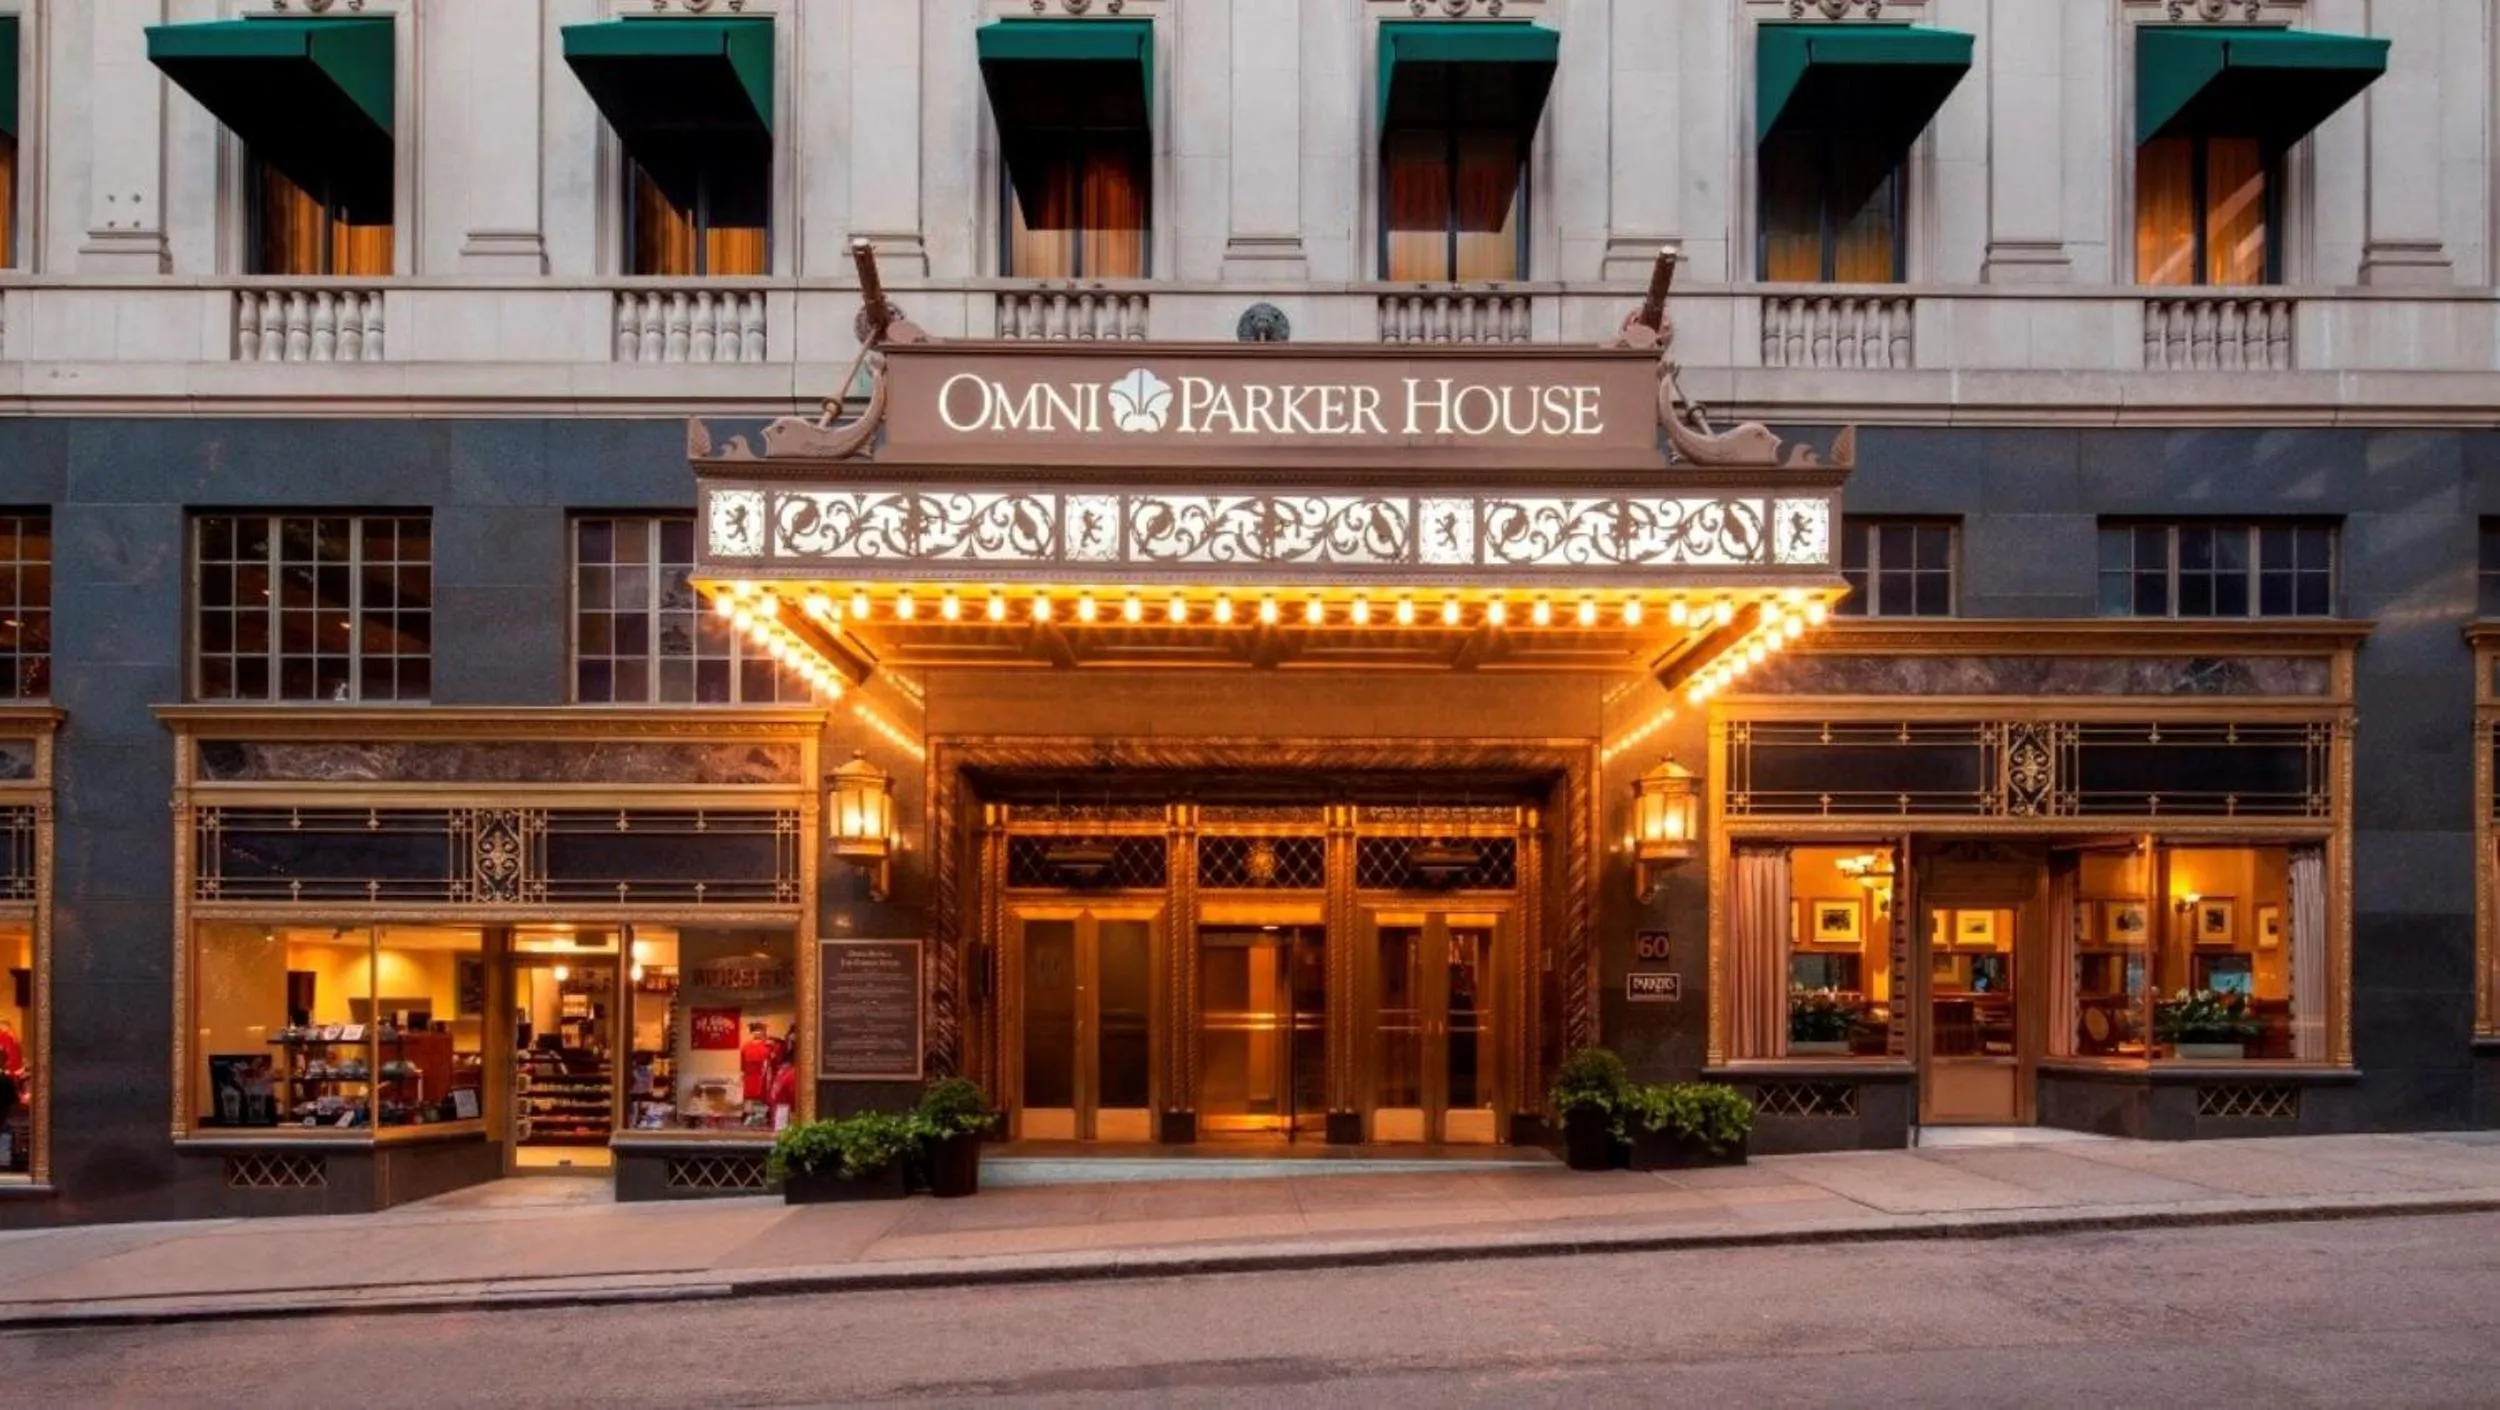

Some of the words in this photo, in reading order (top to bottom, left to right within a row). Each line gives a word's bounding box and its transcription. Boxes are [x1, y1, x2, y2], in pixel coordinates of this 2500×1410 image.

[938, 373, 1103, 432] OMNI
[1176, 376, 1388, 434] PARKER
[1401, 377, 1604, 435] HOUSE
[1639, 935, 1670, 958] 60
